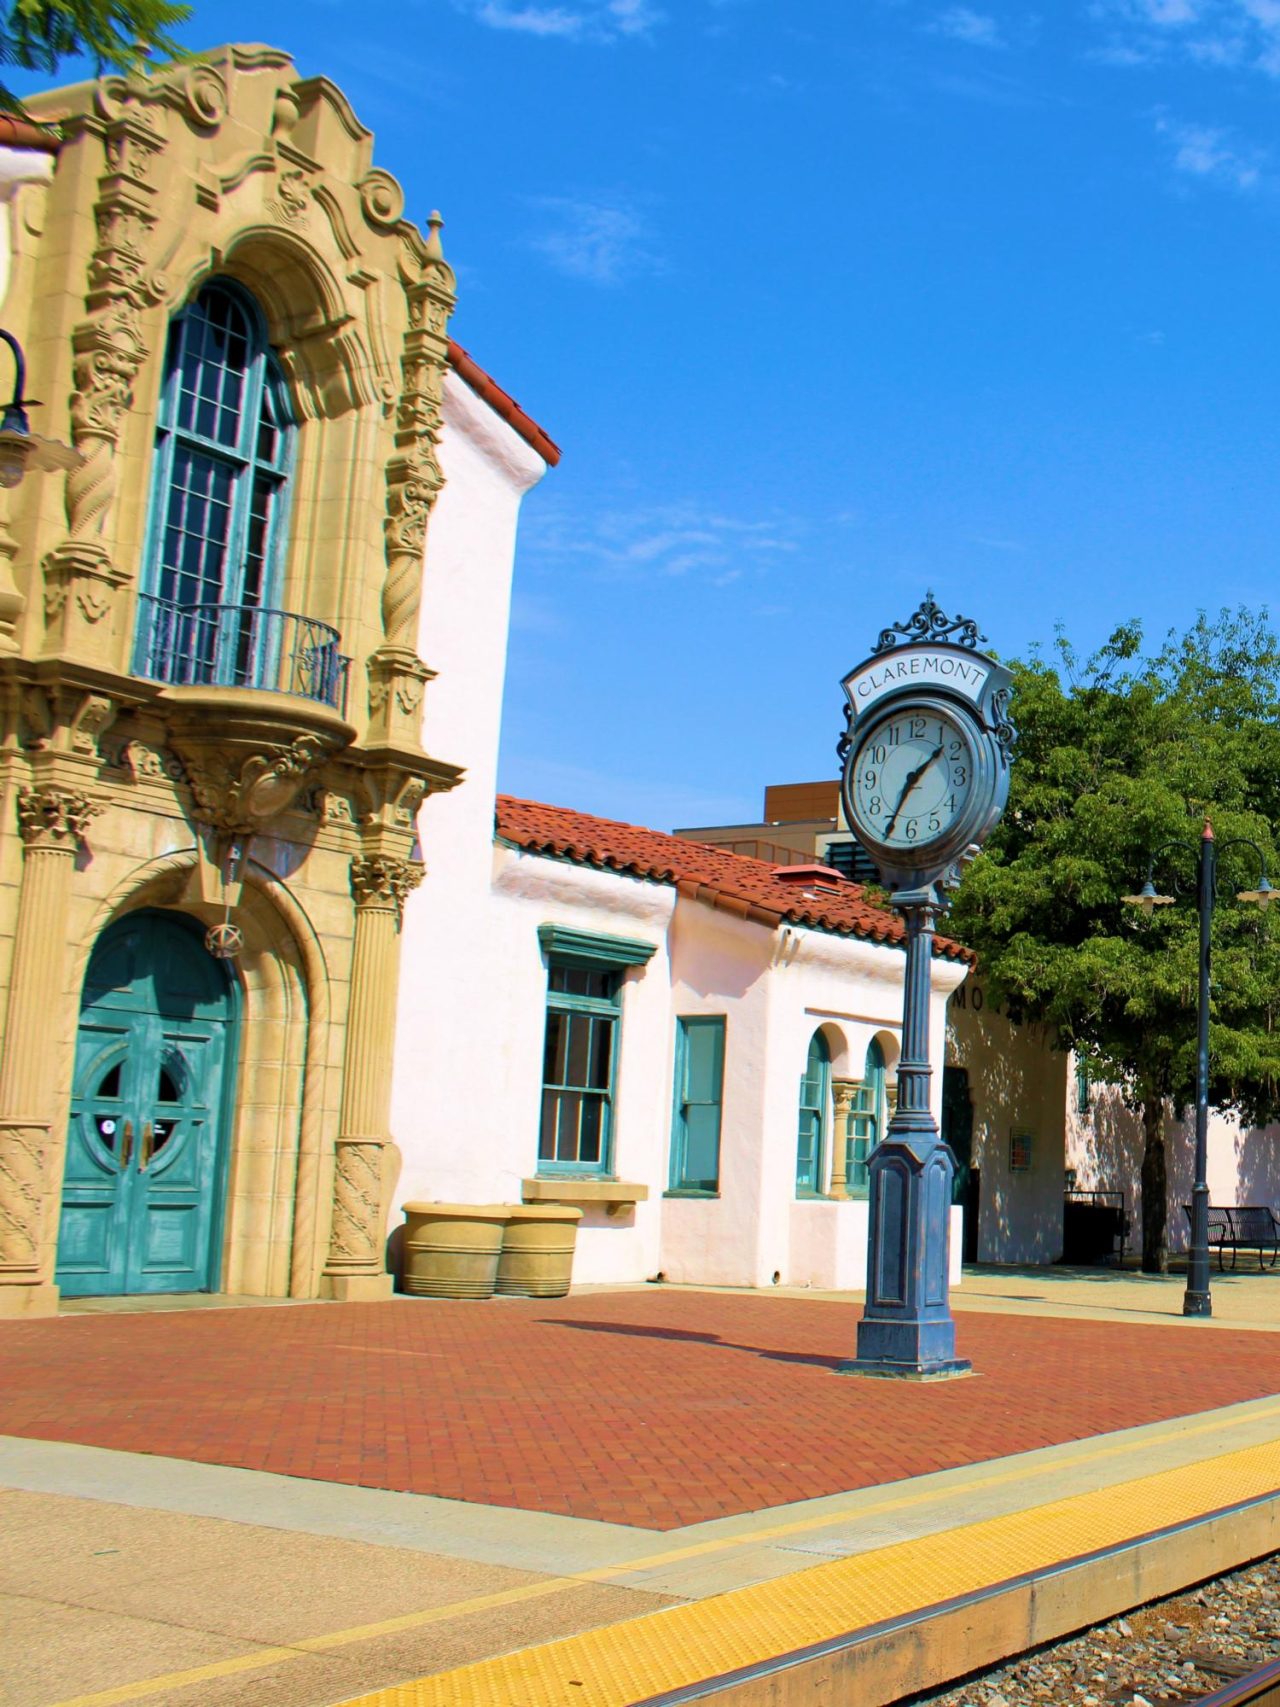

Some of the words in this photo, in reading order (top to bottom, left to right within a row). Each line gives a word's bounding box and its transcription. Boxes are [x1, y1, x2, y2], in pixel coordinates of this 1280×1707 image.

[857, 657, 985, 697] CLAREMONT
[888, 727, 899, 745] 11
[909, 719, 926, 738] 12
[938, 726, 944, 744] 1
[871, 745, 886, 764] 10
[950, 741, 962, 760] 2
[865, 770, 876, 790] 9
[953, 766, 966, 786] 3
[869, 796, 881, 815] 8
[943, 794, 957, 813] 4
[905, 818, 918, 839] 6
[928, 811, 940, 831] 5
